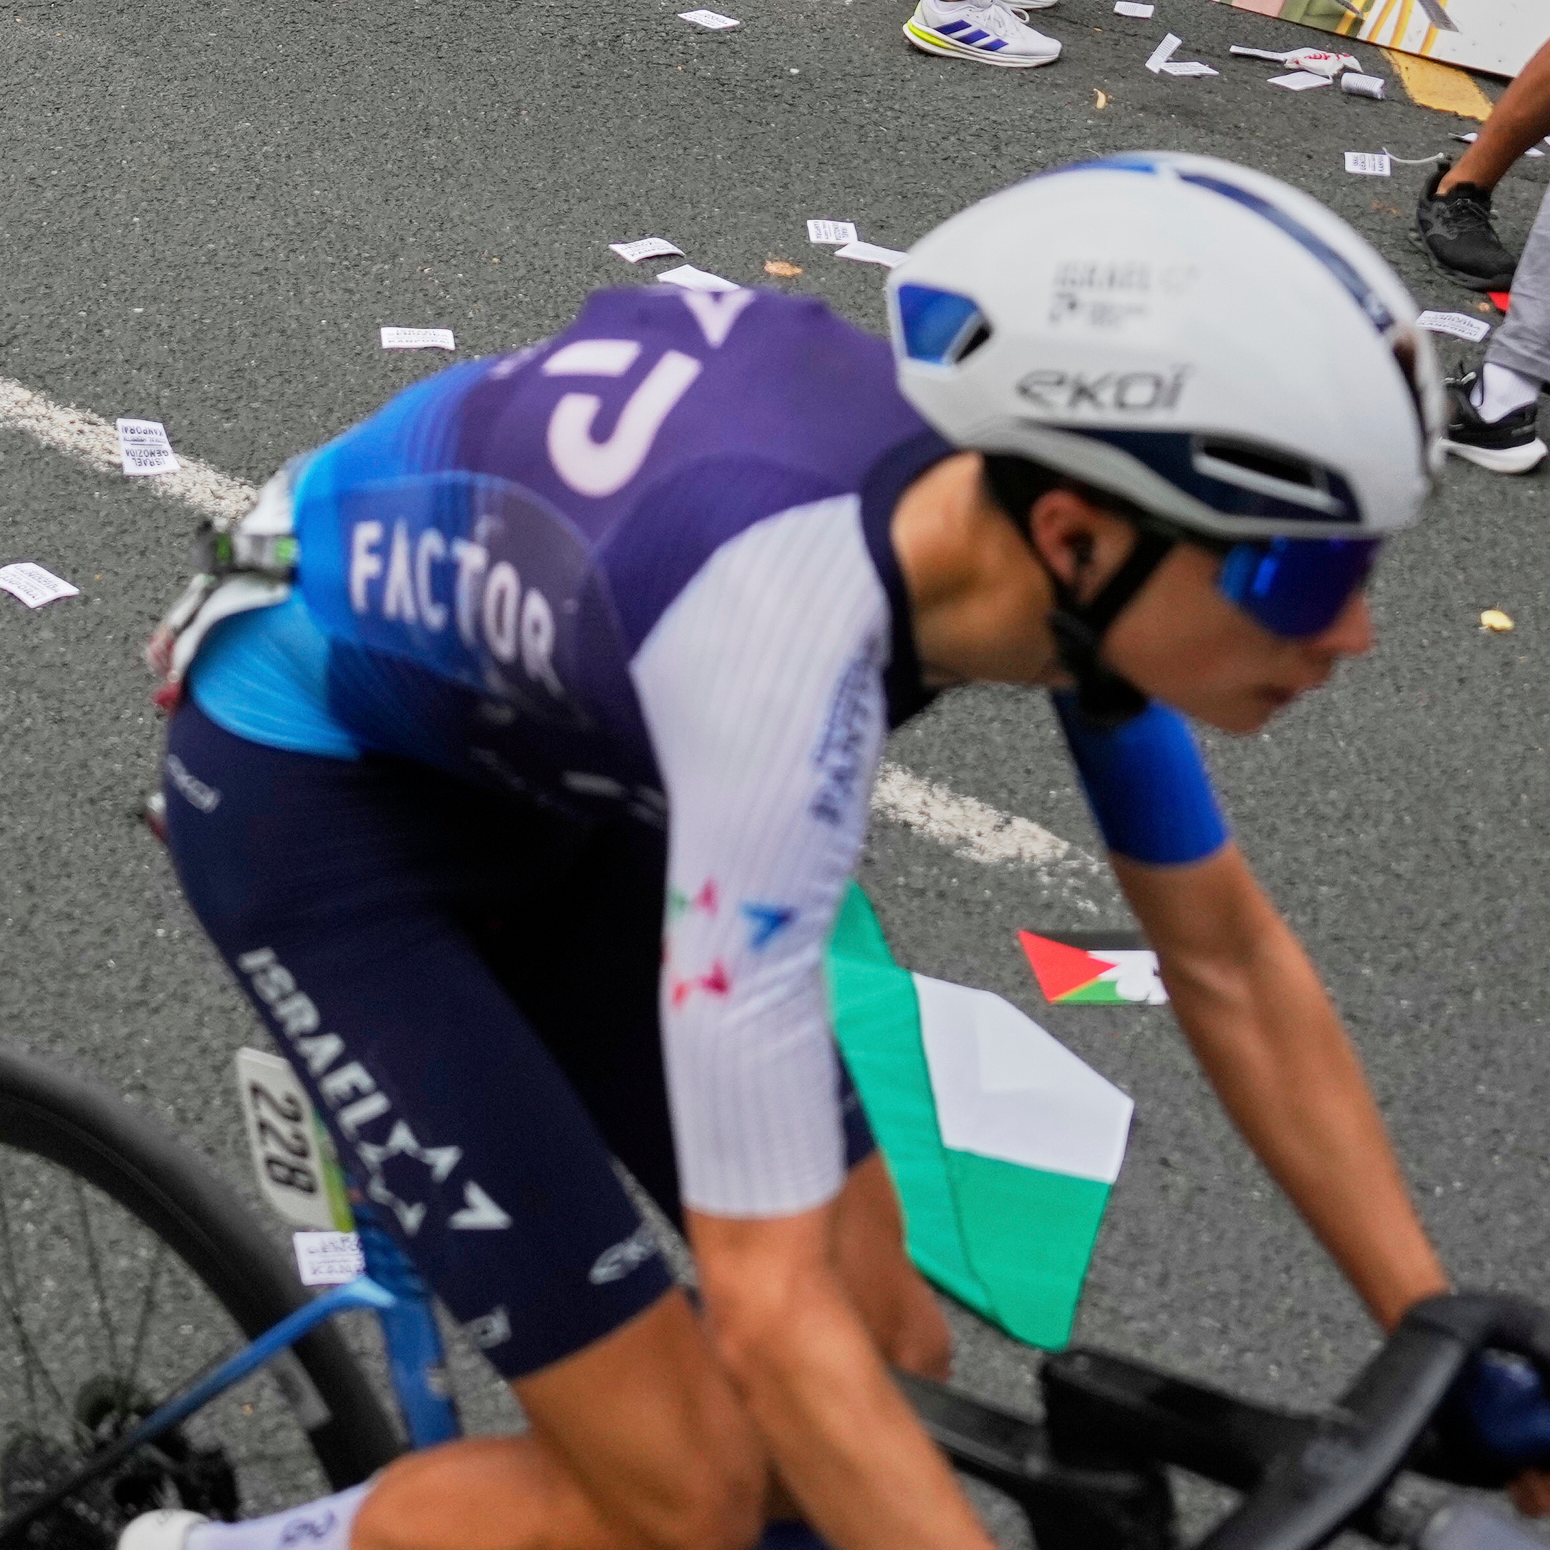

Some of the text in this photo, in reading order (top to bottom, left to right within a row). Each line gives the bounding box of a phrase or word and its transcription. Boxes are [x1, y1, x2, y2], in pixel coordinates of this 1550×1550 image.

[121, 425, 164, 436] KANPORA!
[125, 449, 169, 458] GENOZIDA
[134, 458, 166, 467] ISRAEL
[352, 518, 566, 695] FACTOR
[236, 945, 392, 1142] ISRAEL
[251, 1086, 318, 1194] 228
